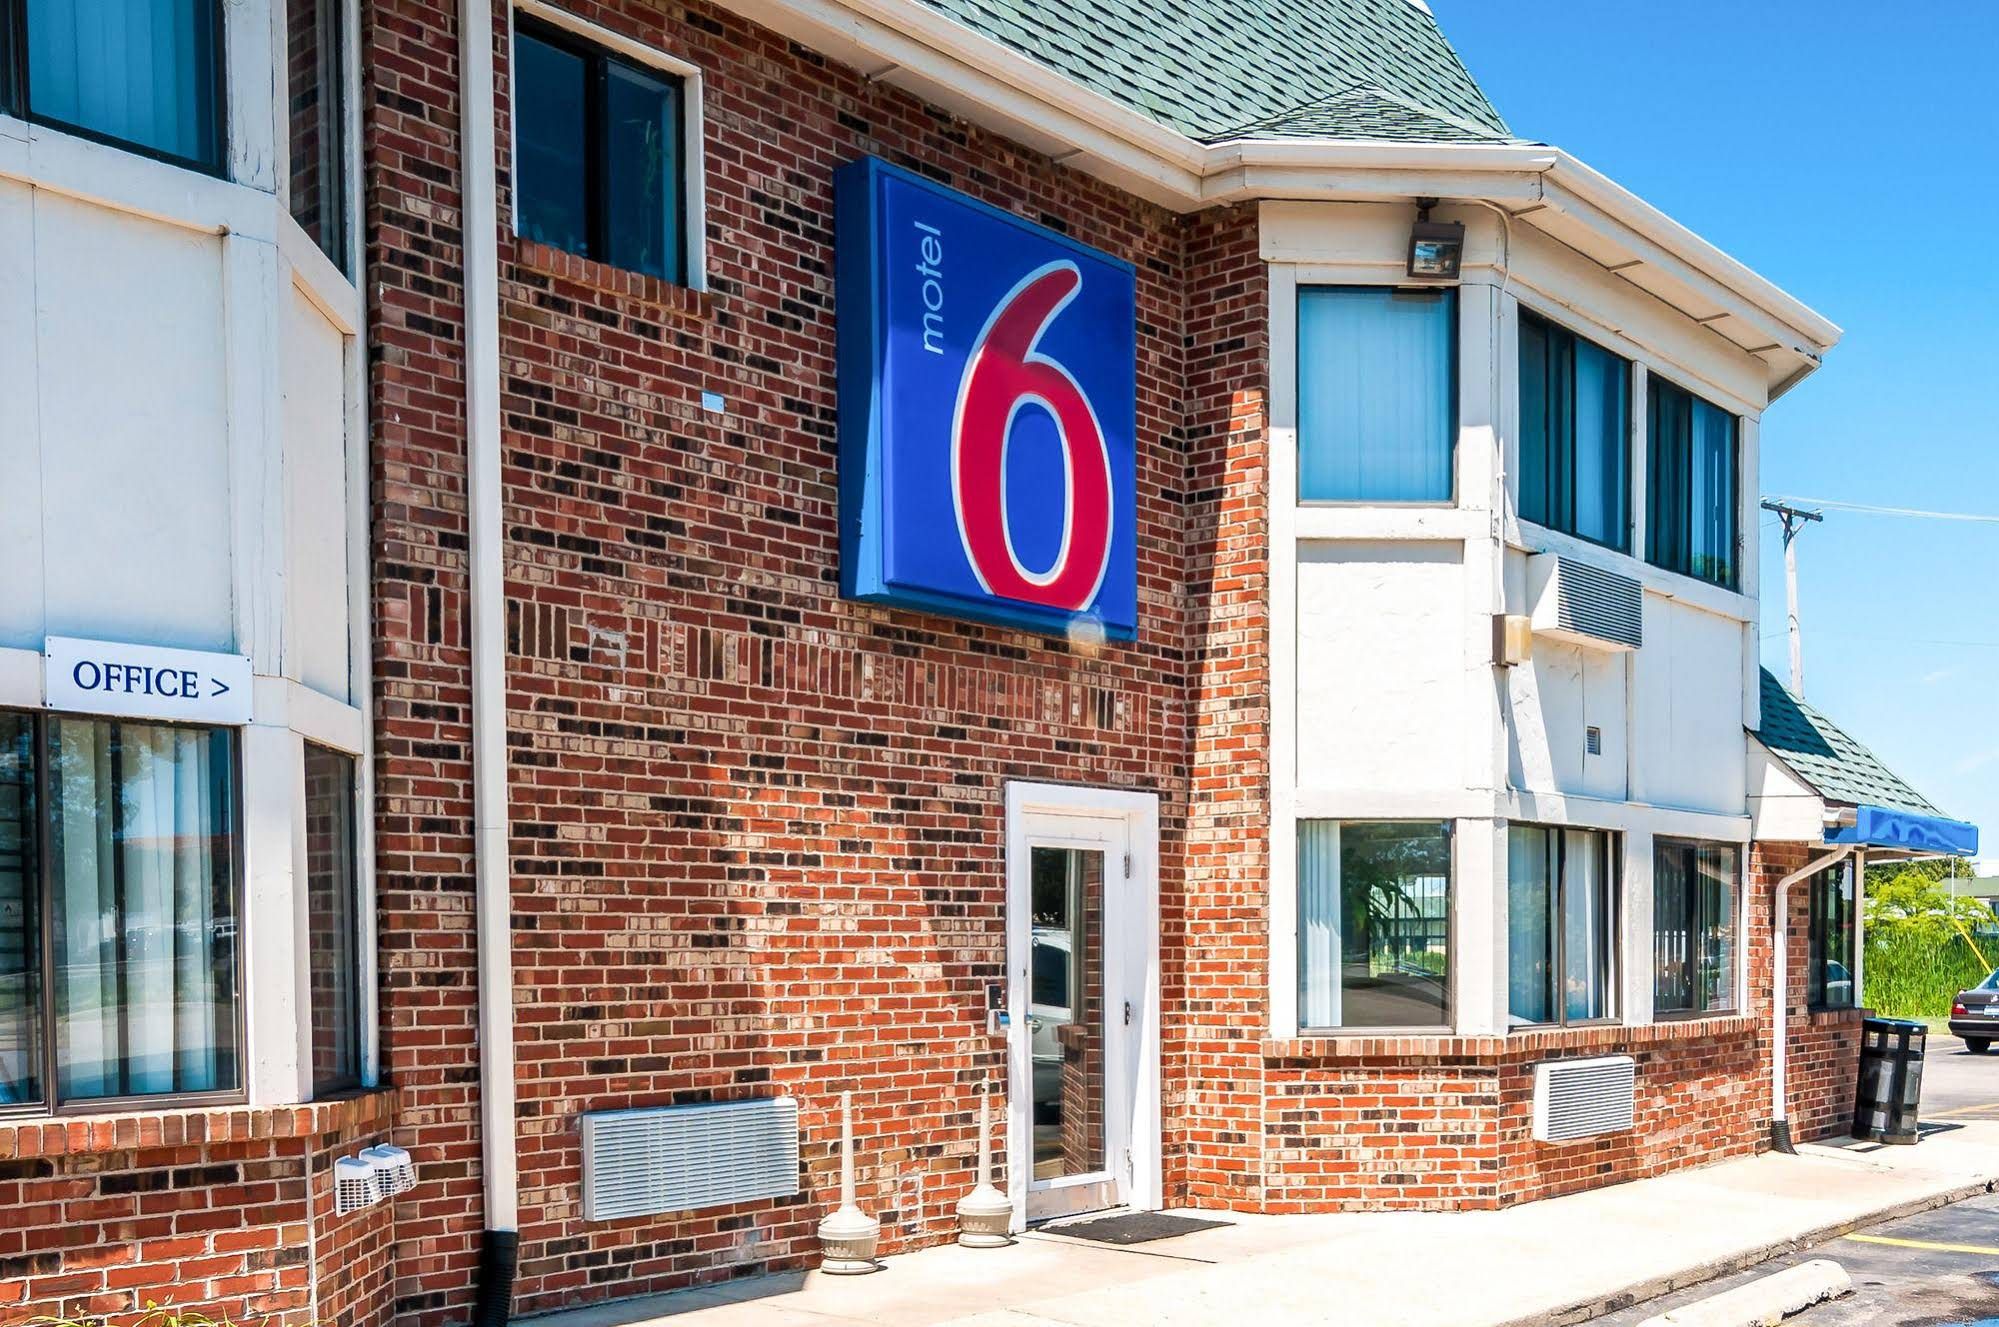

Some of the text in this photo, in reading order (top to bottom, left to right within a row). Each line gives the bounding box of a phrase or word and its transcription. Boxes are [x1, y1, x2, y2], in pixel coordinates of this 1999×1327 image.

[914, 221, 944, 355] motel
[950, 259, 1114, 612] 6
[73, 661, 199, 698] OFFICE
